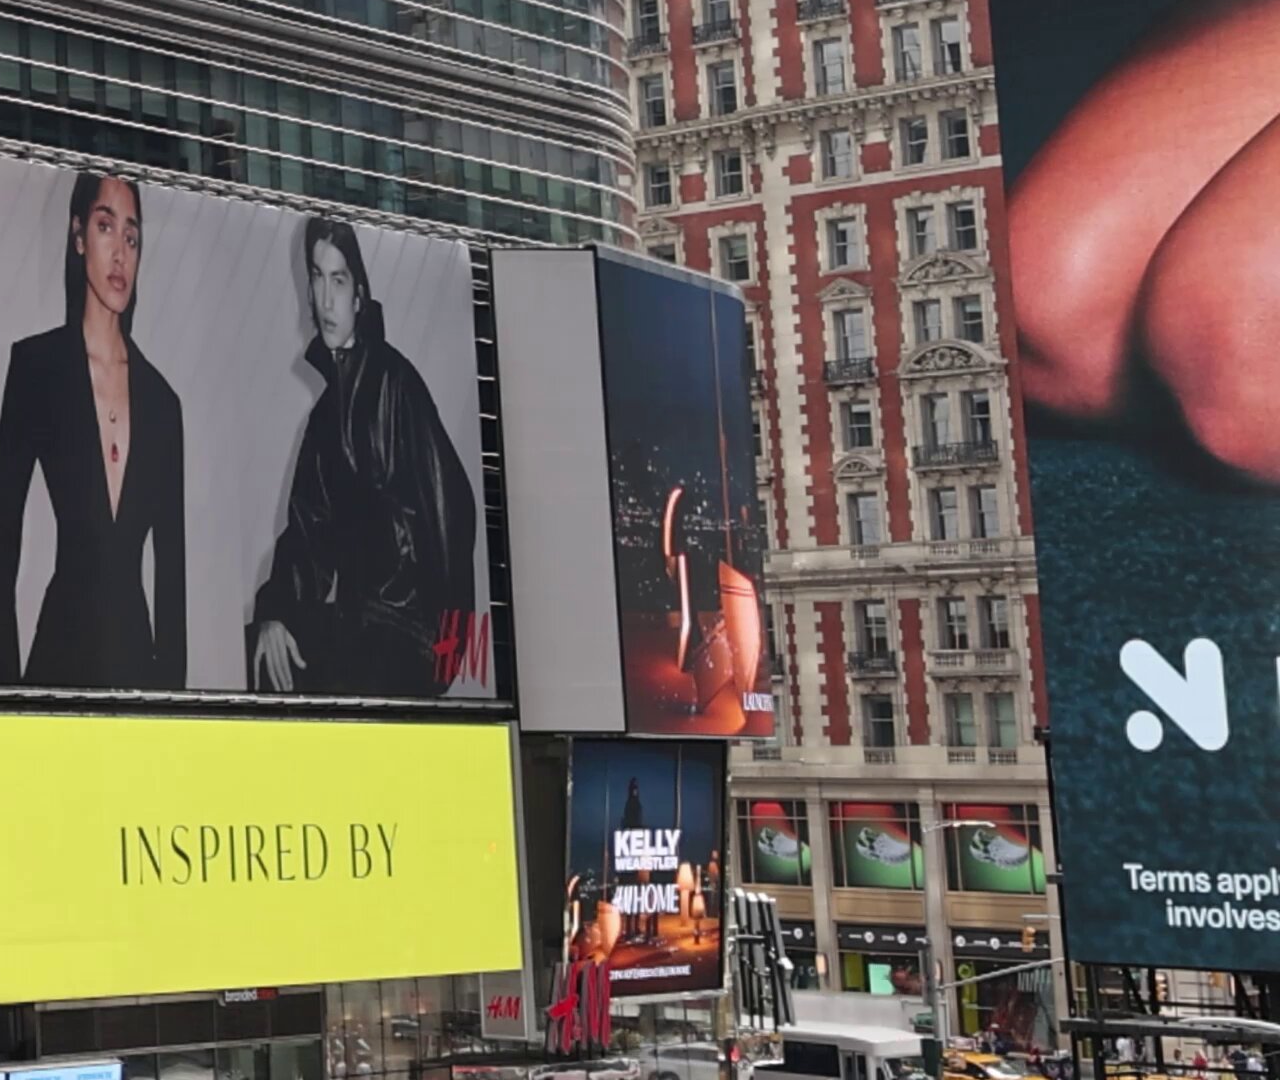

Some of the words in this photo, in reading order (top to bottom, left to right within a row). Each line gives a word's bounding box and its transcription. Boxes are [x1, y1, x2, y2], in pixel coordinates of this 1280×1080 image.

[120, 823, 330, 886] INSPIRED
[350, 822, 398, 880] BY
[614, 829, 681, 857] KELLY
[1123, 862, 1212, 894] Terms
[1217, 867, 1280, 902] appl
[1166, 898, 1280, 931] involves
